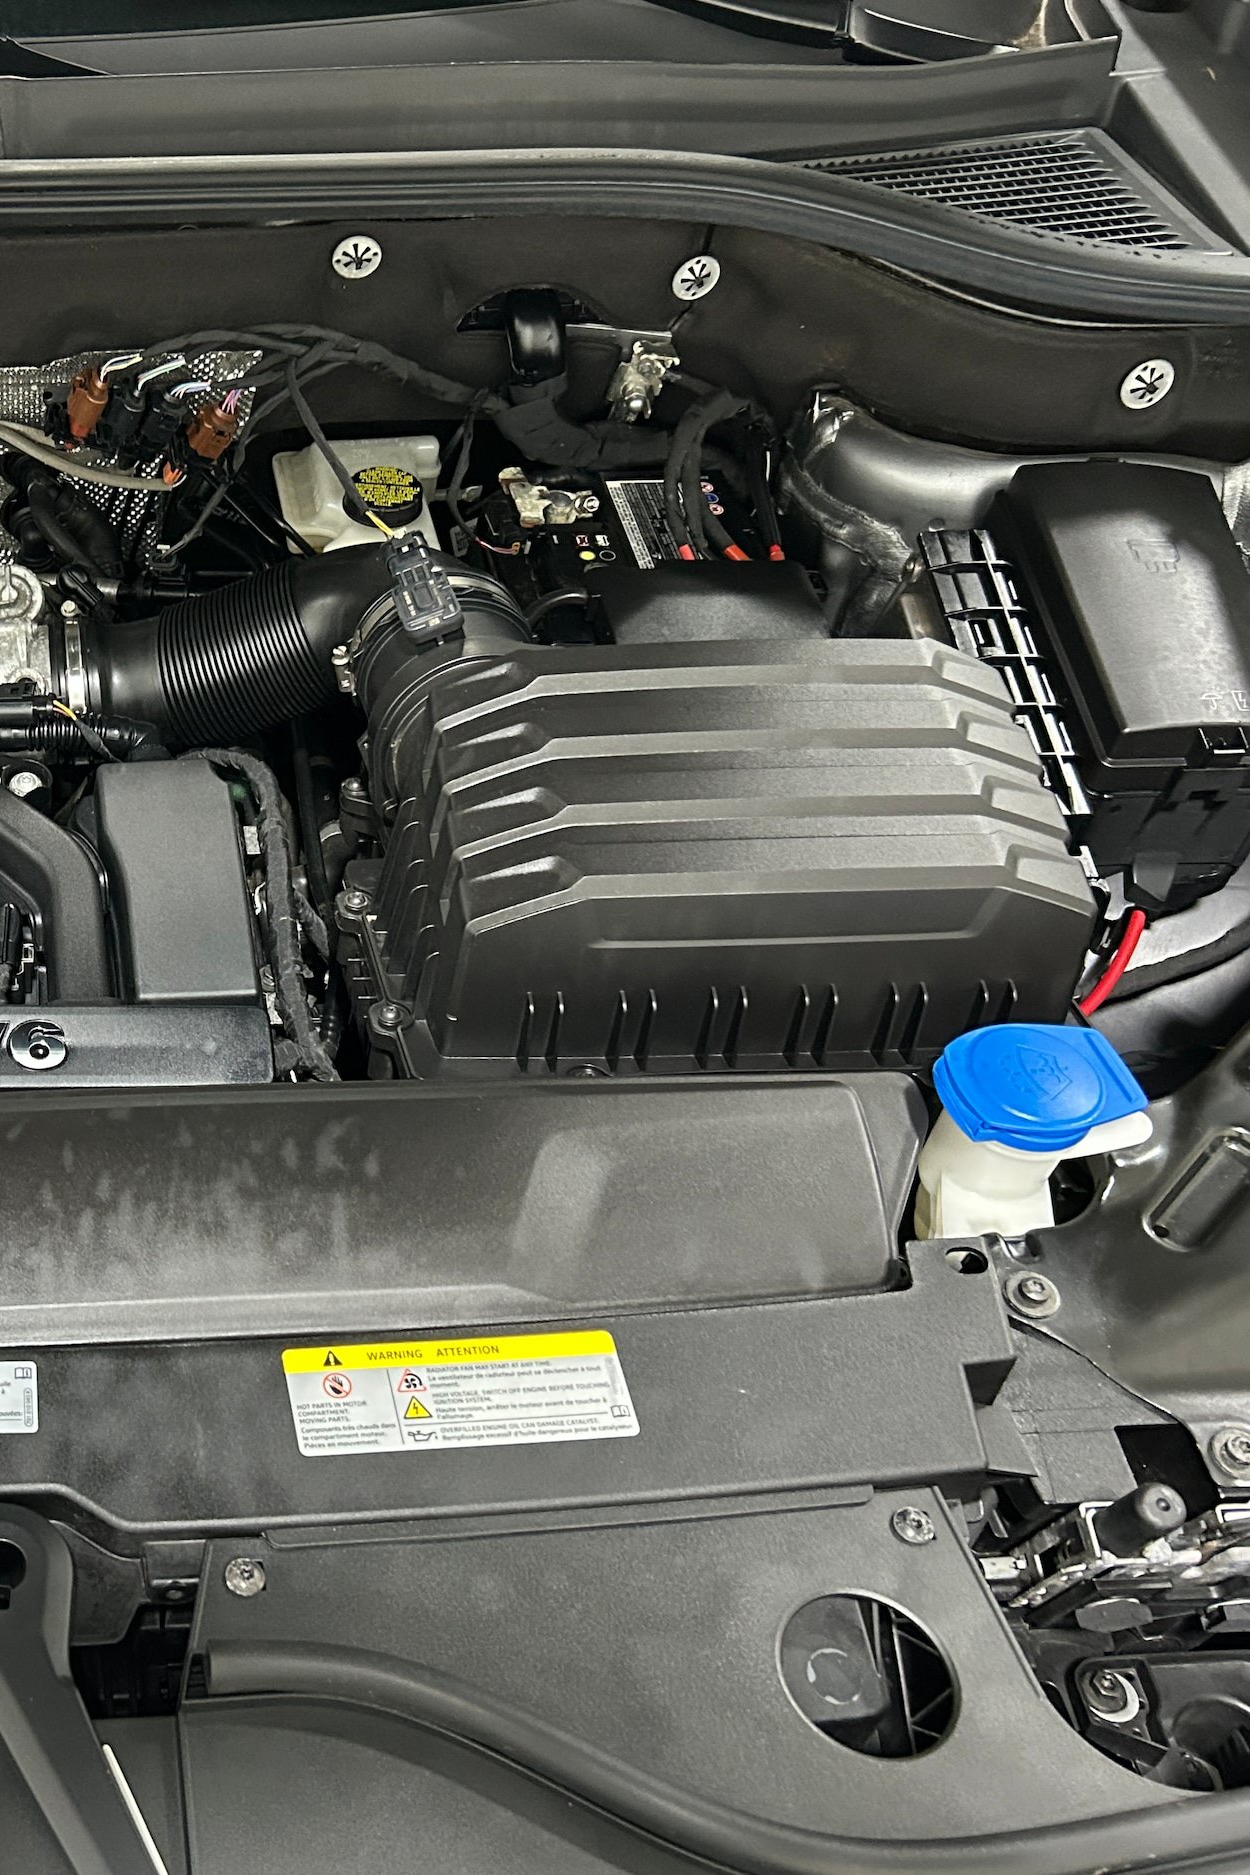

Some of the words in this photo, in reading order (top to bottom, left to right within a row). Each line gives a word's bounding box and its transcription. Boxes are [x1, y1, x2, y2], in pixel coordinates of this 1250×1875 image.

[366, 1349, 423, 1360] WARNING
[436, 1345, 500, 1357] ATTENTION
[548, 1384, 574, 1392] BEFORE
[536, 1420, 565, 1428] DAMAGE
[310, 1432, 359, 1442] compartiment
